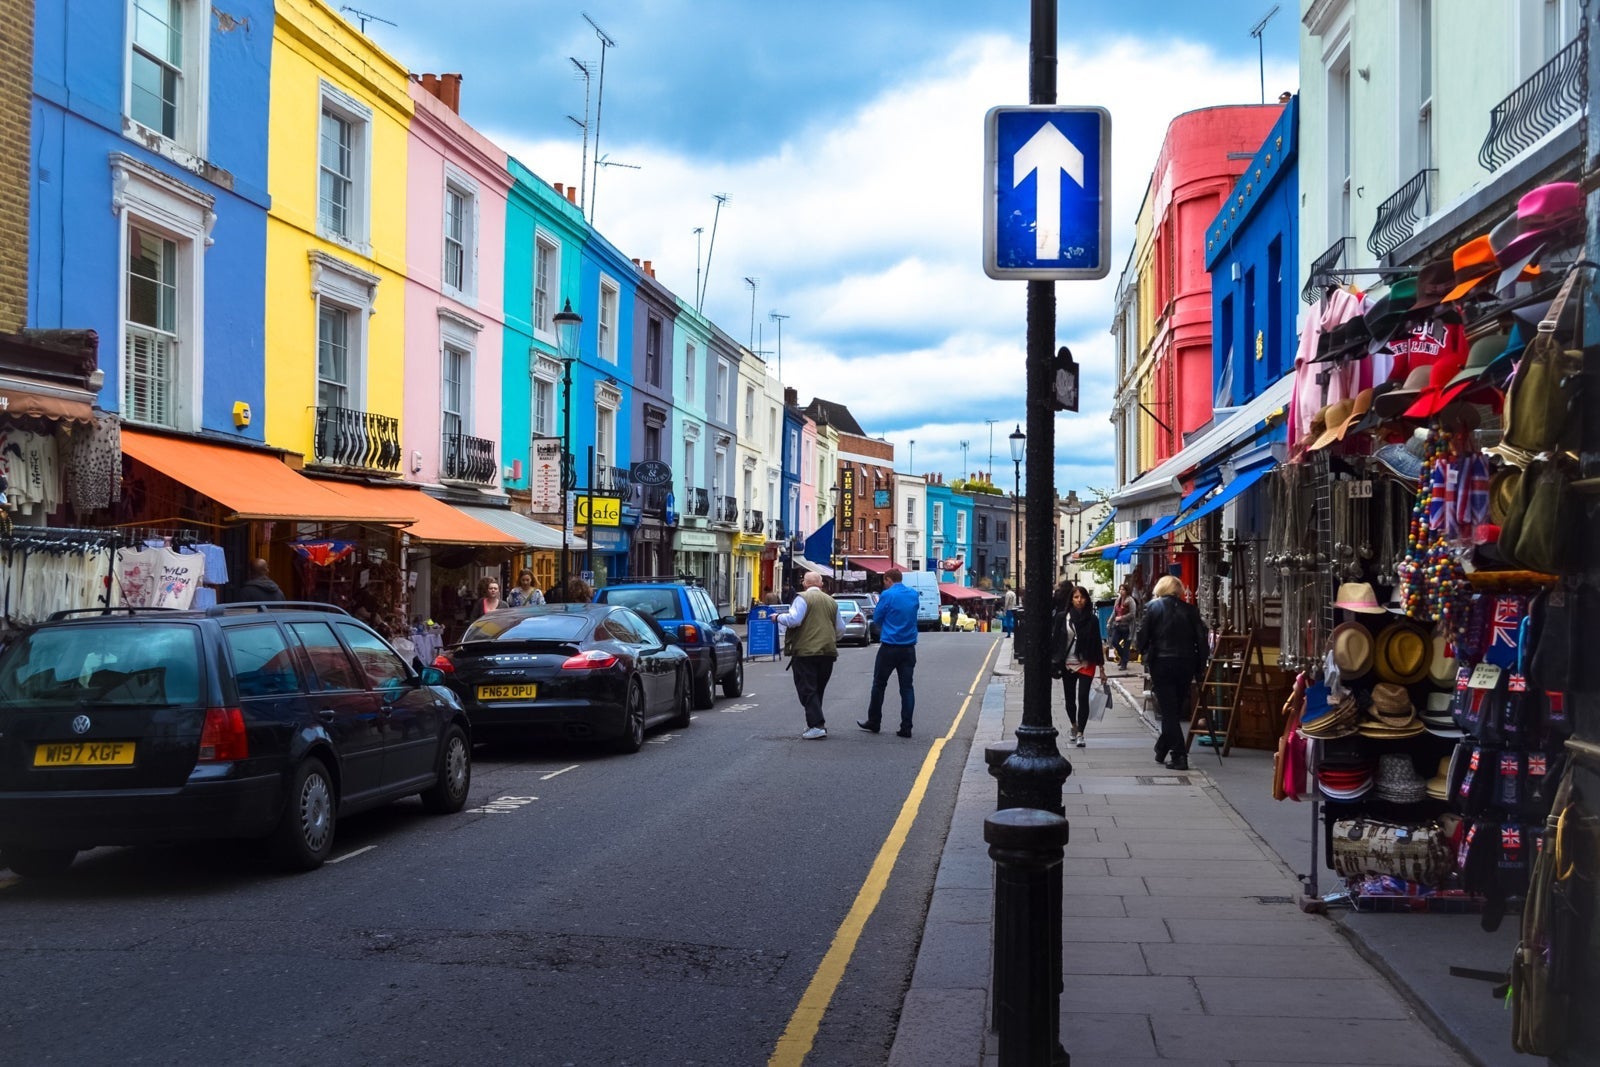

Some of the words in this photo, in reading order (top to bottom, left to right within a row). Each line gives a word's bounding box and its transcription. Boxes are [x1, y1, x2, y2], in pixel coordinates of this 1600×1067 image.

[844, 471, 852, 490] THE
[844, 493, 852, 518] GOLD
[163, 566, 189, 576] WILD
[482, 687, 509, 697] FN62
[46, 745, 83, 763] W197
[88, 744, 123, 761] XGF
